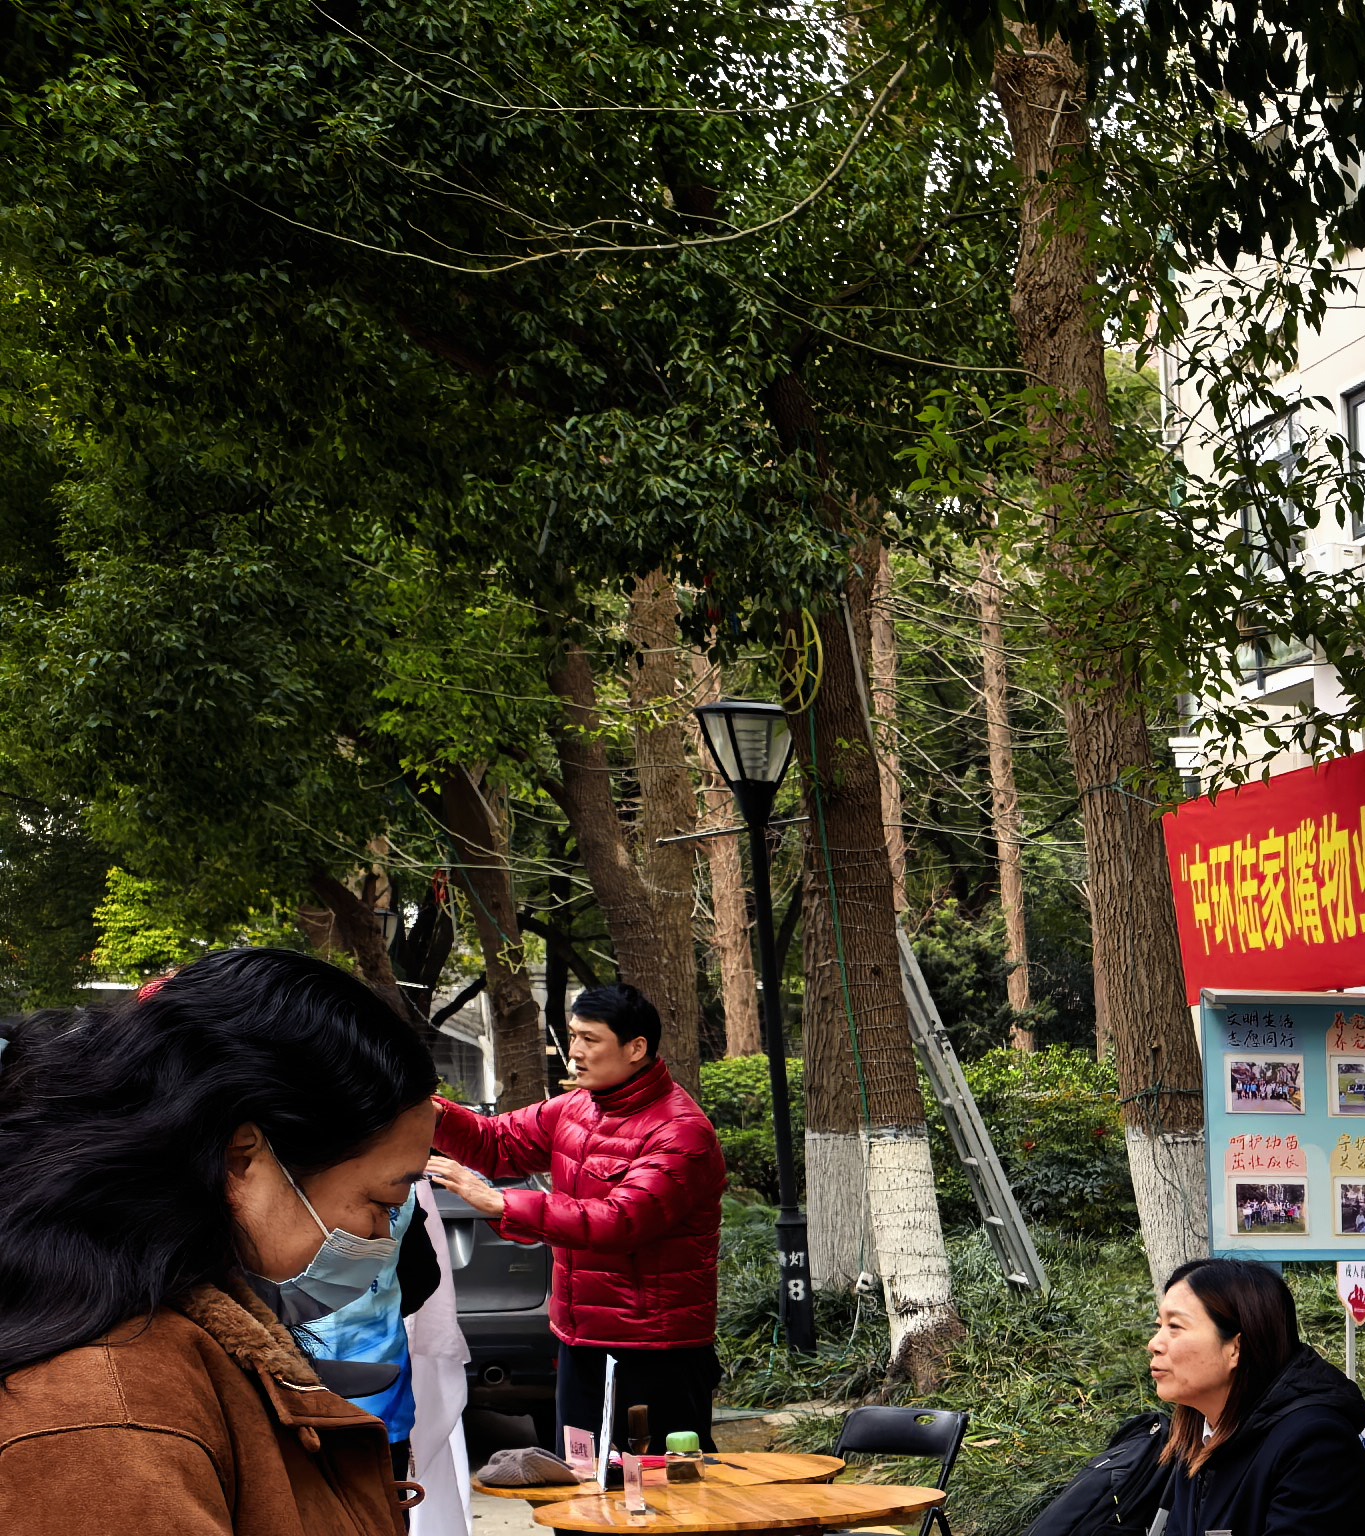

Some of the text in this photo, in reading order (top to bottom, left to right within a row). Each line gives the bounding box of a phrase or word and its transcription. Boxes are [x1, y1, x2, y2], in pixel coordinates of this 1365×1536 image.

[1226, 1031, 1296, 1050] 志愿同行
[788, 1279, 805, 1301] 8
